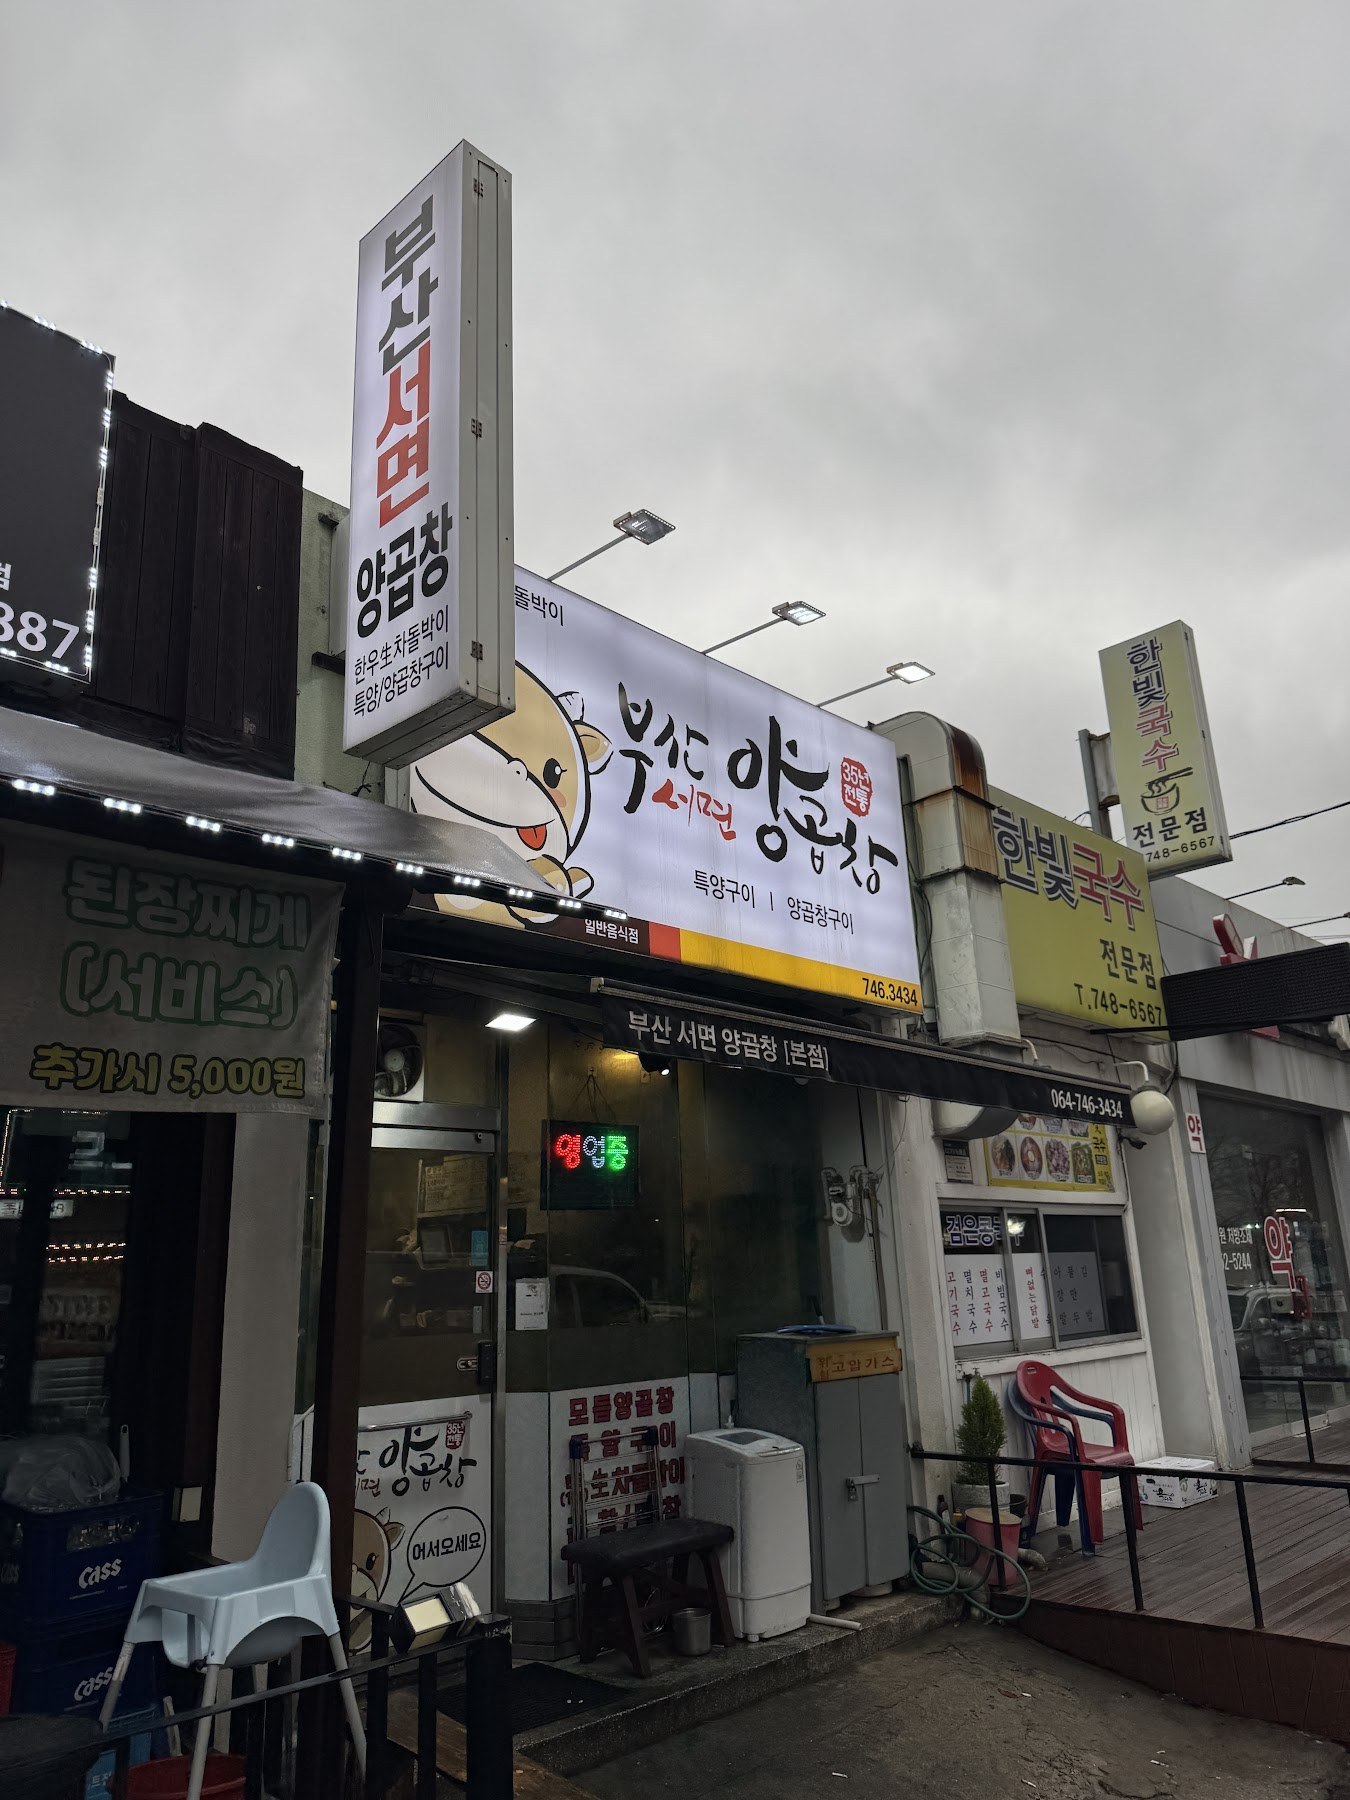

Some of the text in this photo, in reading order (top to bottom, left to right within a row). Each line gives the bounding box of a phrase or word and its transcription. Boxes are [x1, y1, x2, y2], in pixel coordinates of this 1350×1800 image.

[356, 501, 452, 638] 양곱창
[1126, 636, 1179, 773] 한빛국수
[618, 681, 899, 895] 부산 서면 양곱창
[842, 761, 872, 785] 35년
[842, 782, 869, 815] 전통
[1132, 806, 1208, 848] 전문점
[992, 806, 1145, 931] 한빛국수
[1145, 835, 1216, 864] 748-6567
[693, 869, 855, 935] 특양구이 양곱창구이
[584, 918, 639, 945] 일반음식점
[60, 940, 299, 1031] (서비스)
[1099, 937, 1157, 991] 전문점
[862, 977, 918, 1006] 746.3434
[1073, 983, 1163, 1027] T.748-6567
[628, 1010, 830, 1071] 부산 서면 양곱창 [본점]
[29, 1042, 306, 1099] 추가시 5,000원
[1050, 1088, 1124, 1119] 064-746-3434
[555, 1133, 629, 1170] 영업중
[1221, 1252, 1252, 1270] 2-5244
[1264, 1216, 1297, 1292] 약
[379, 1427, 478, 1497] 양곱창
[412, 1531, 482, 1561] 어서오세요
[78, 1558, 122, 1589] Cass
[74, 1666, 114, 1701] Cass
